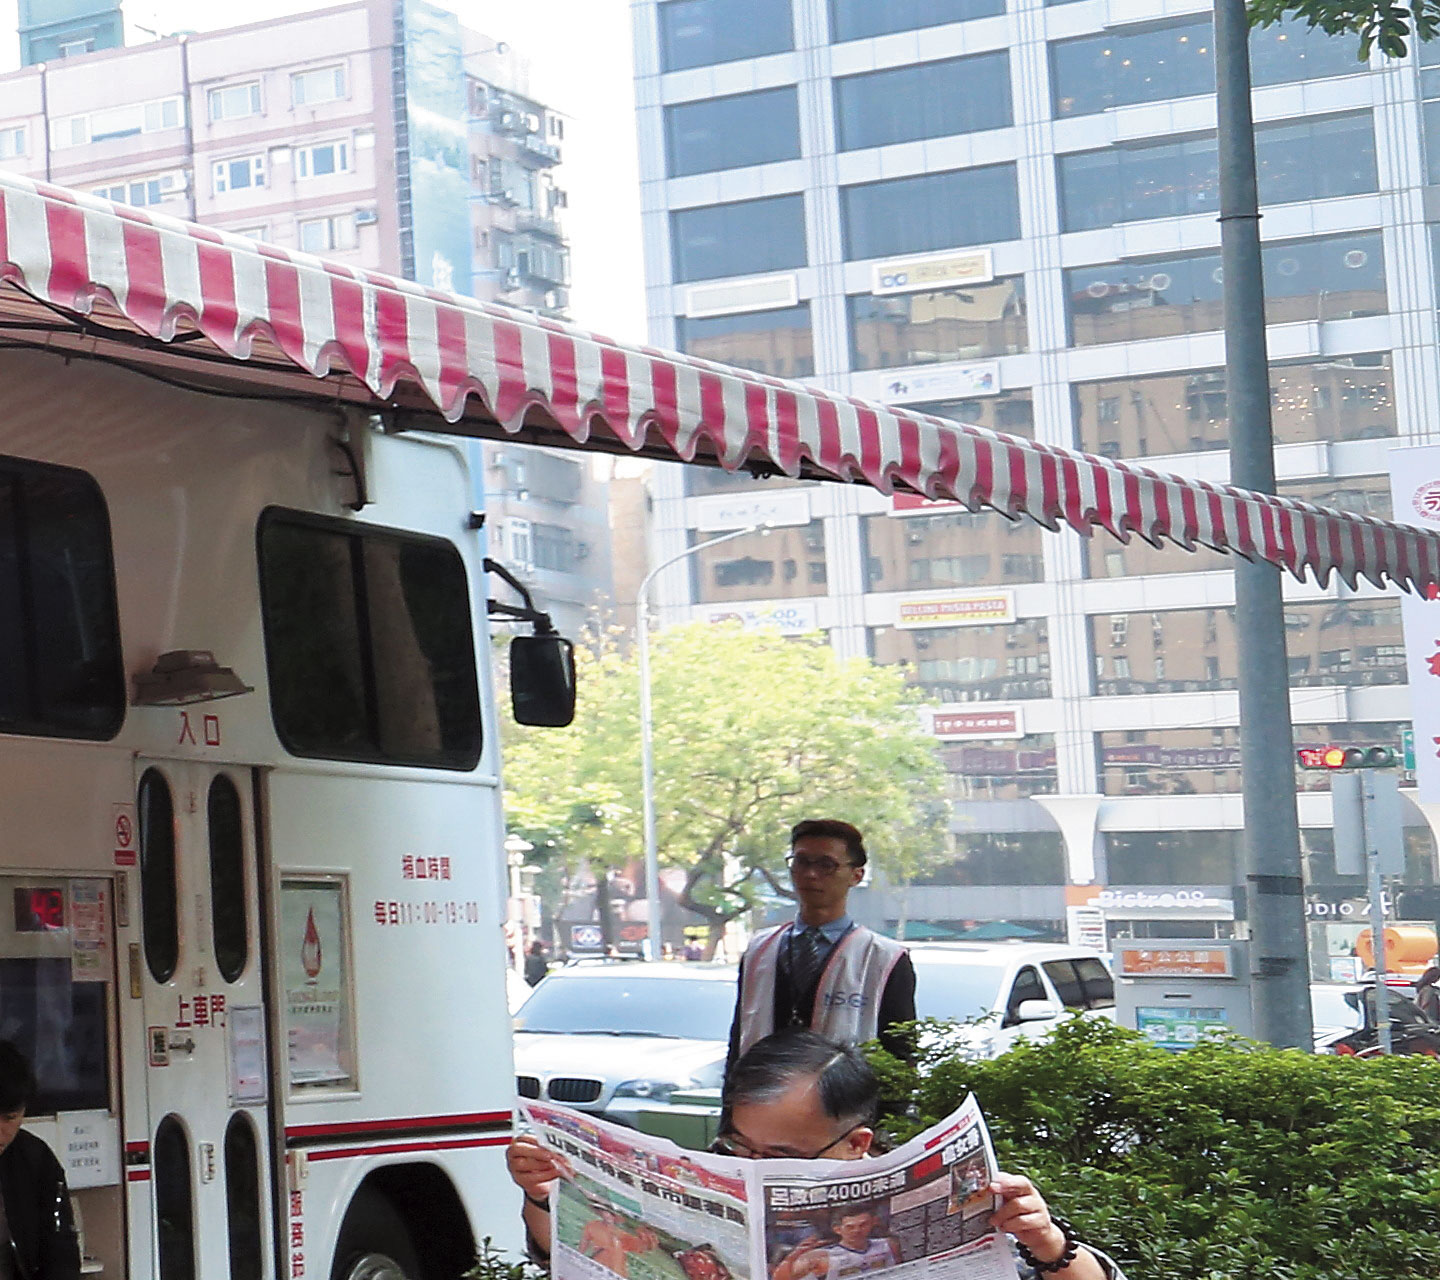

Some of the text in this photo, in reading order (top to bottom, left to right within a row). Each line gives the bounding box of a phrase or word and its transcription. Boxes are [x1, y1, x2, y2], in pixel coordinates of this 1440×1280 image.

[179, 711, 220, 746] 入口
[176, 994, 225, 1027] 上車門
